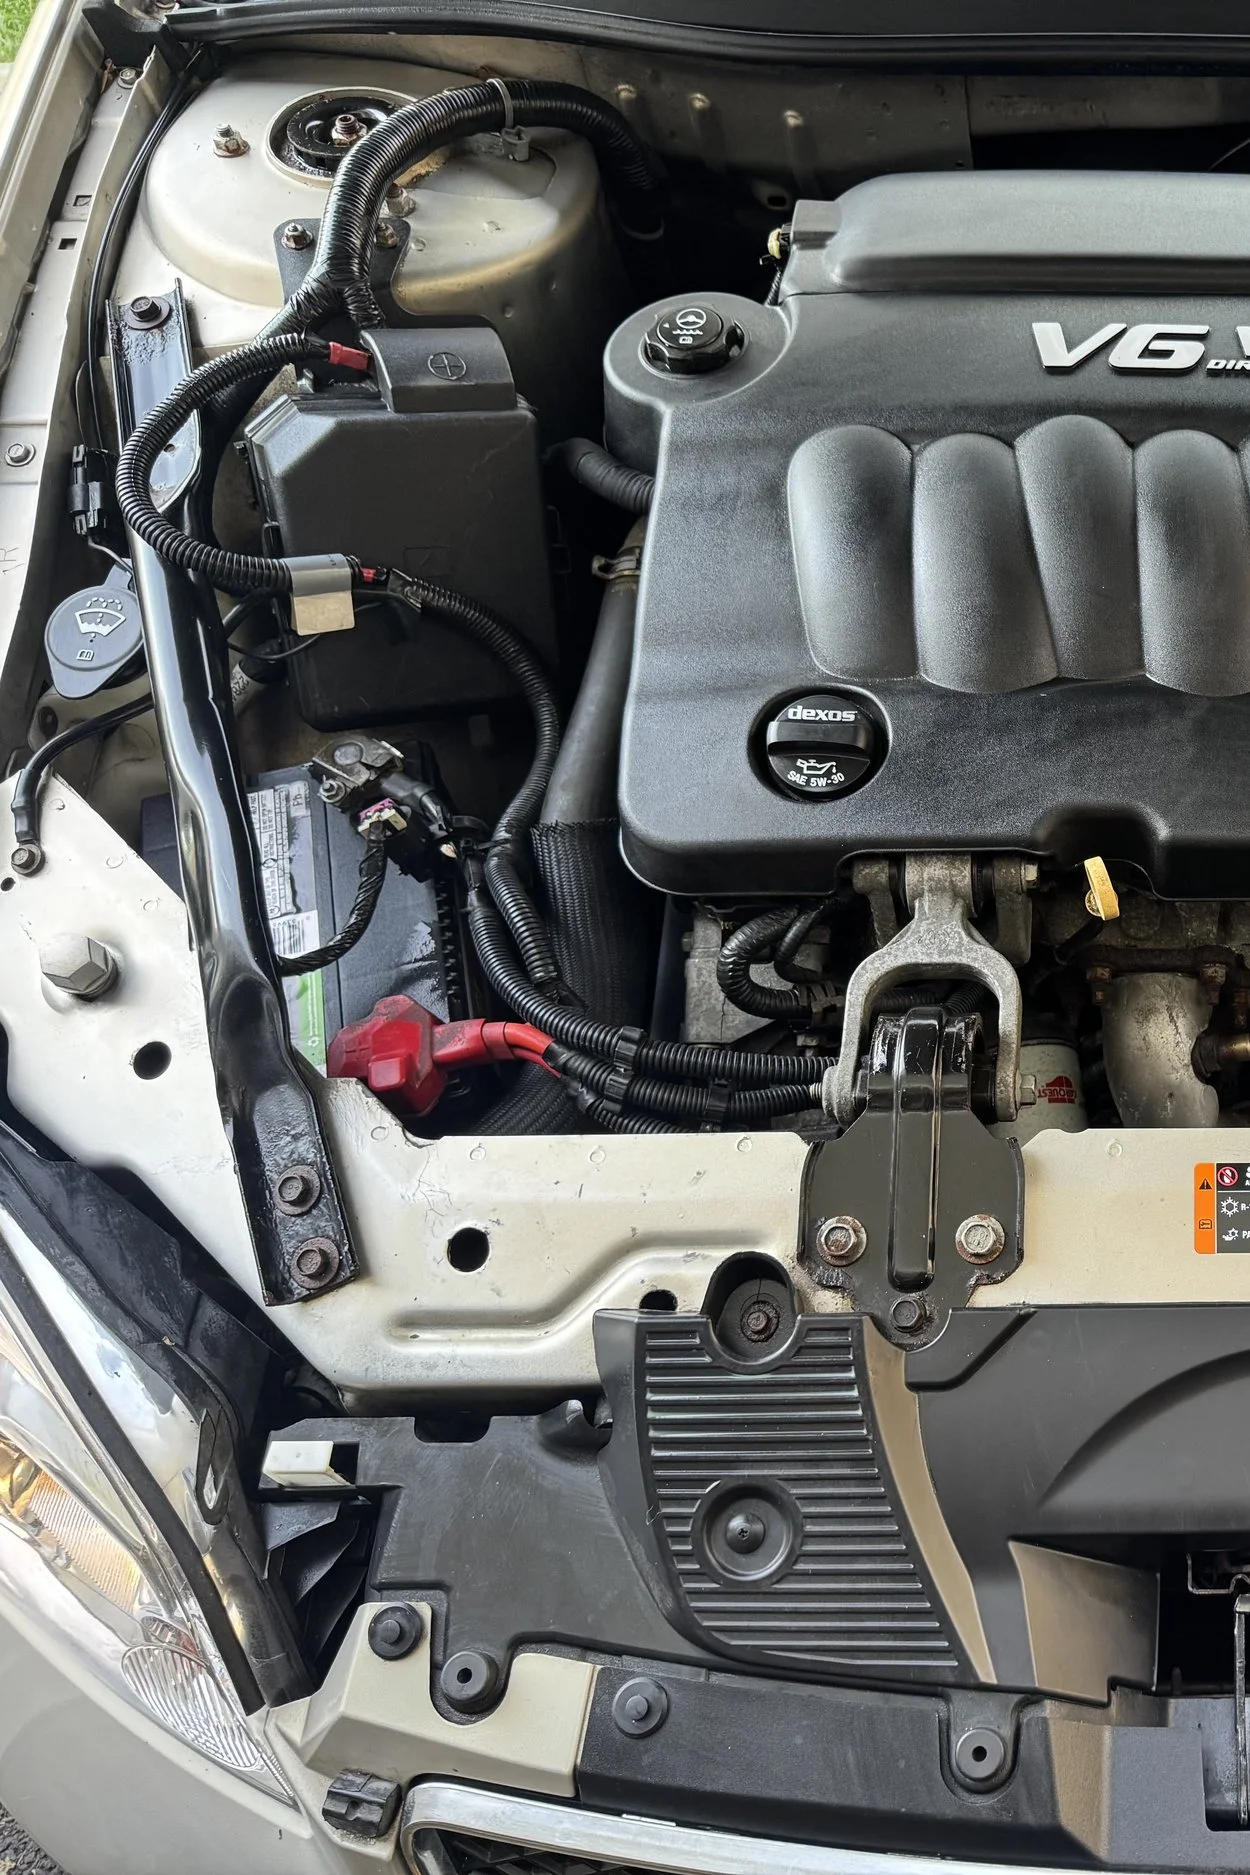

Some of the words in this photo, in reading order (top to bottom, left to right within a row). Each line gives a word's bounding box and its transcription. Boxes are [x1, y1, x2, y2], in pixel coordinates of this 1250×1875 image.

[1032, 322, 1210, 369] V6
[787, 705, 859, 722] dexos
[787, 770, 808, 785] SAE
[810, 772, 845, 787] 5W-30
[1037, 1088, 1076, 1098] CQUEST
